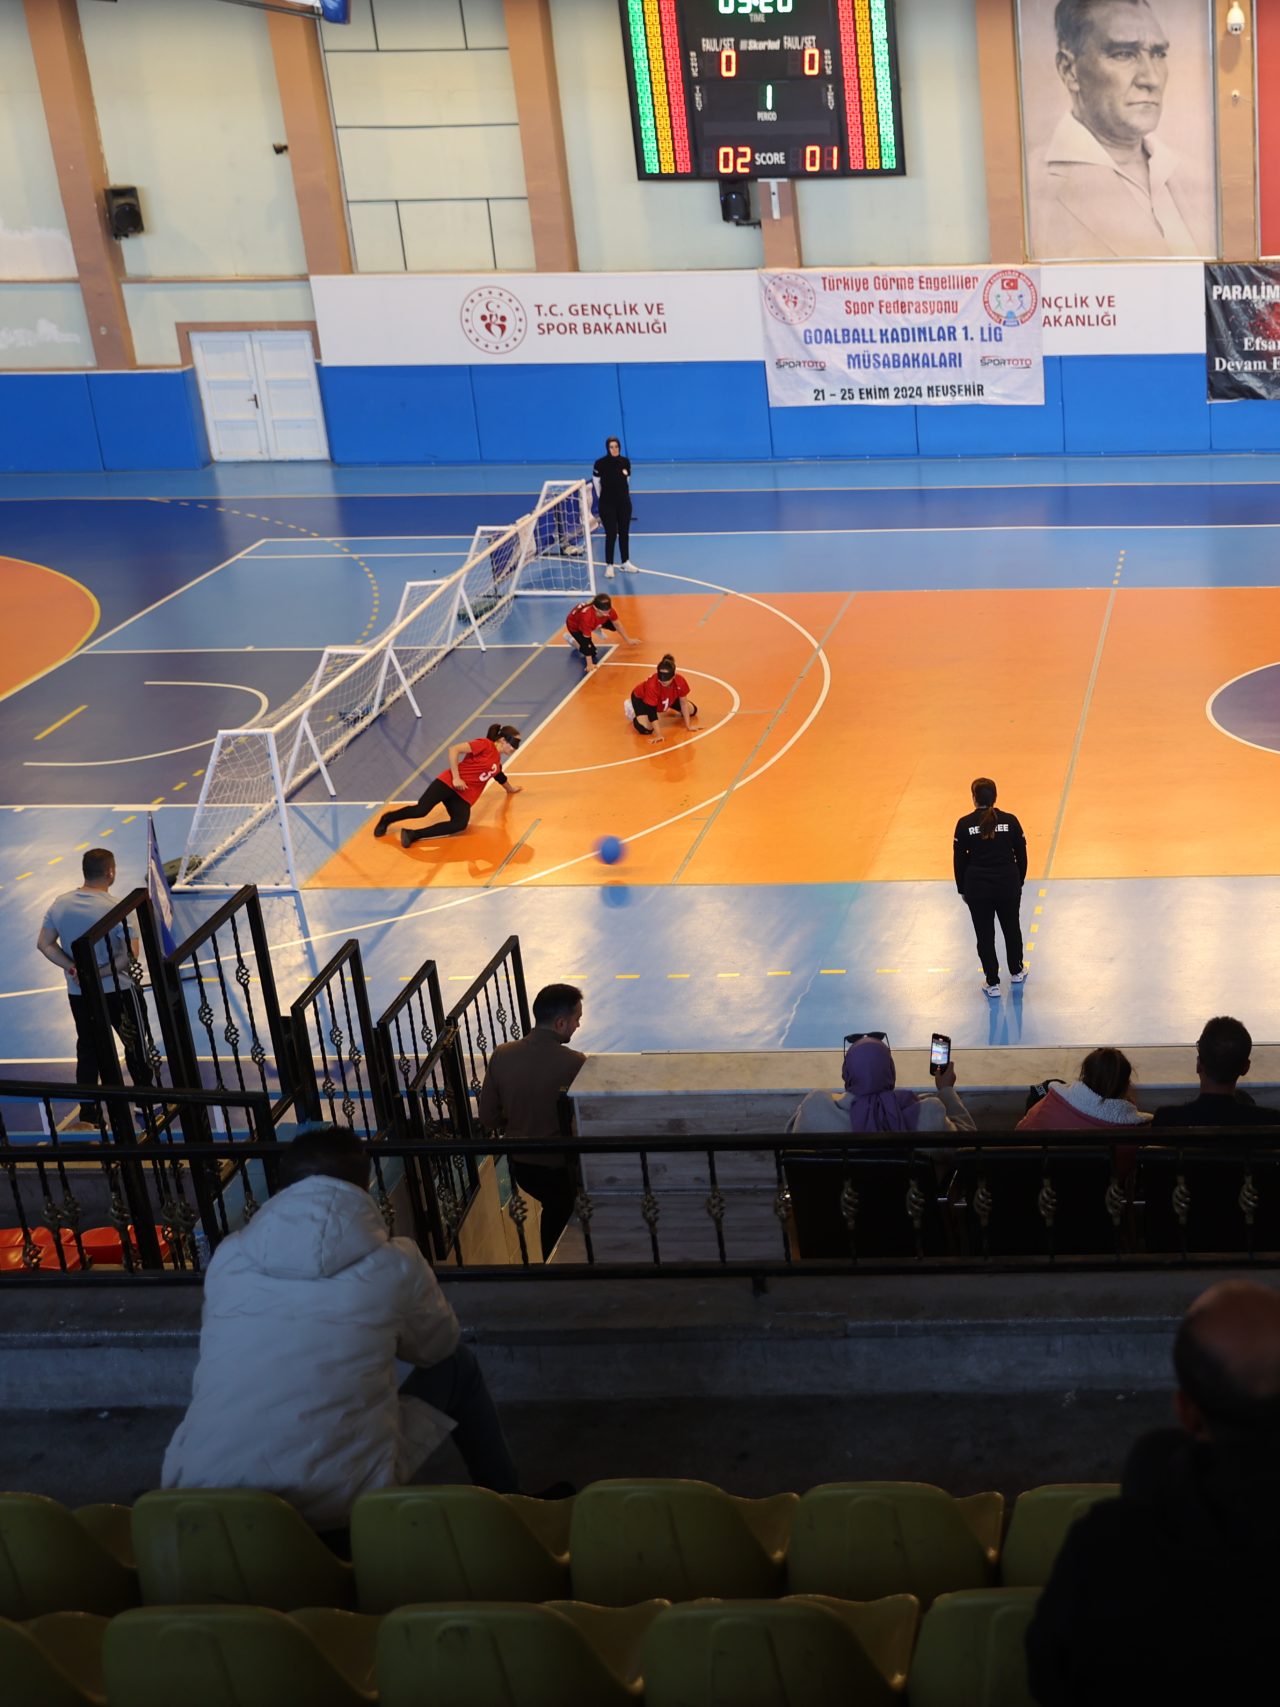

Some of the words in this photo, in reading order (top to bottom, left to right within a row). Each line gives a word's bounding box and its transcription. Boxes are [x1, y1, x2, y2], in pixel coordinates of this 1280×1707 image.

[702, 37, 735, 52] FAUL/SET
[783, 35, 816, 50] FAUL/SET
[720, 50, 736, 77] 0
[804, 48, 820, 76] 0
[718, 146, 751, 174] 02
[755, 152, 785, 165] SCORE
[805, 145, 838, 172] 01
[821, 275, 870, 292] Türkiye
[873, 274, 915, 291] Görme
[918, 274, 980, 291] Engelliler
[534, 304, 564, 316] T.C.
[568, 300, 639, 319] GENÇLİK
[644, 303, 665, 316] VE
[844, 300, 874, 316] Spor
[878, 299, 959, 316] Federasyonu
[1042, 293, 1089, 312] NÇLİK
[1096, 295, 1116, 308] VE
[537, 322, 578, 335] SPOR
[583, 318, 667, 335] BAKANLIĞI
[1042, 311, 1117, 328] AKANLIĞI
[803, 327, 877, 345] GOALBALL
[880, 325, 957, 344] KADINLAR
[962, 326, 974, 342] 1.
[980, 324, 1004, 342] LİG
[846, 350, 963, 370] MÜSABAKALARI
[1214, 357, 1268, 372] Devam
[813, 388, 826, 401] 21
[840, 388, 855, 401] 25
[859, 386, 890, 400] EKİM
[893, 386, 923, 400] 2024
[927, 383, 985, 400] NEVŞEHİR
[968, 823, 1009, 836] REEE
